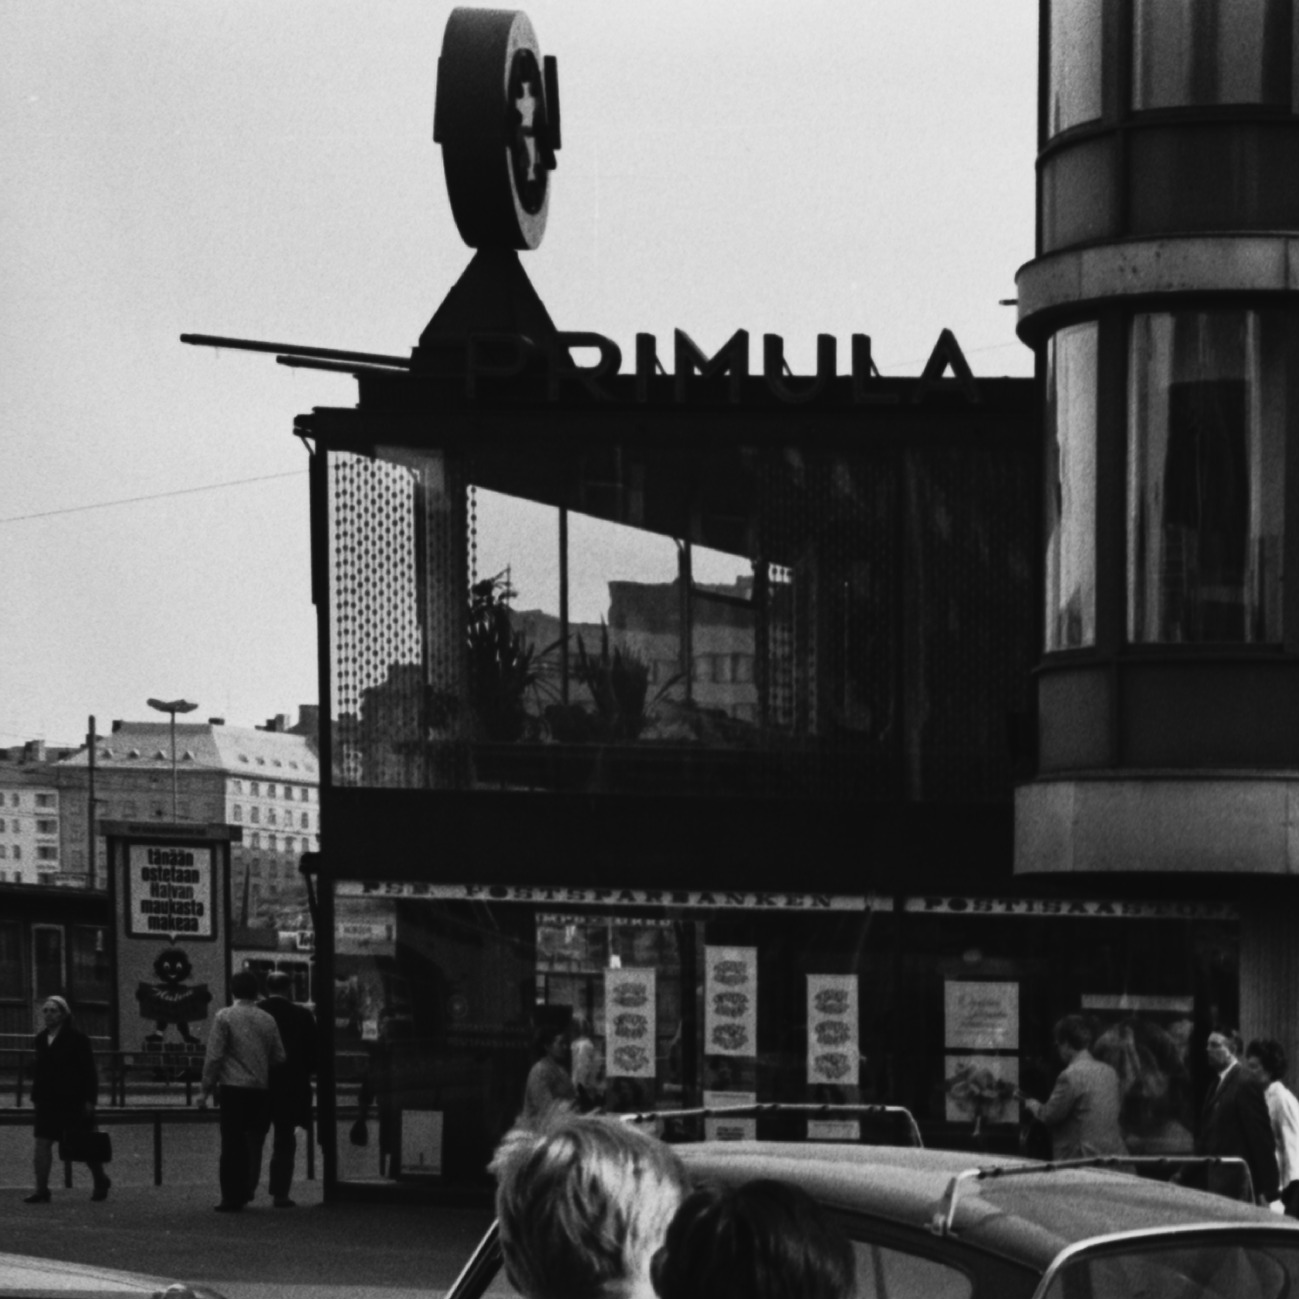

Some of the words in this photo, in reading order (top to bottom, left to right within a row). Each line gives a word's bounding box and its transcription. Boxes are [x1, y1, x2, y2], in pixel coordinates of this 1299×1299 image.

[464, 327, 981, 404] PRIMULA
[147, 848, 194, 867] tänään
[141, 866, 200, 884] ostetaan
[140, 899, 204, 917] maukasta
